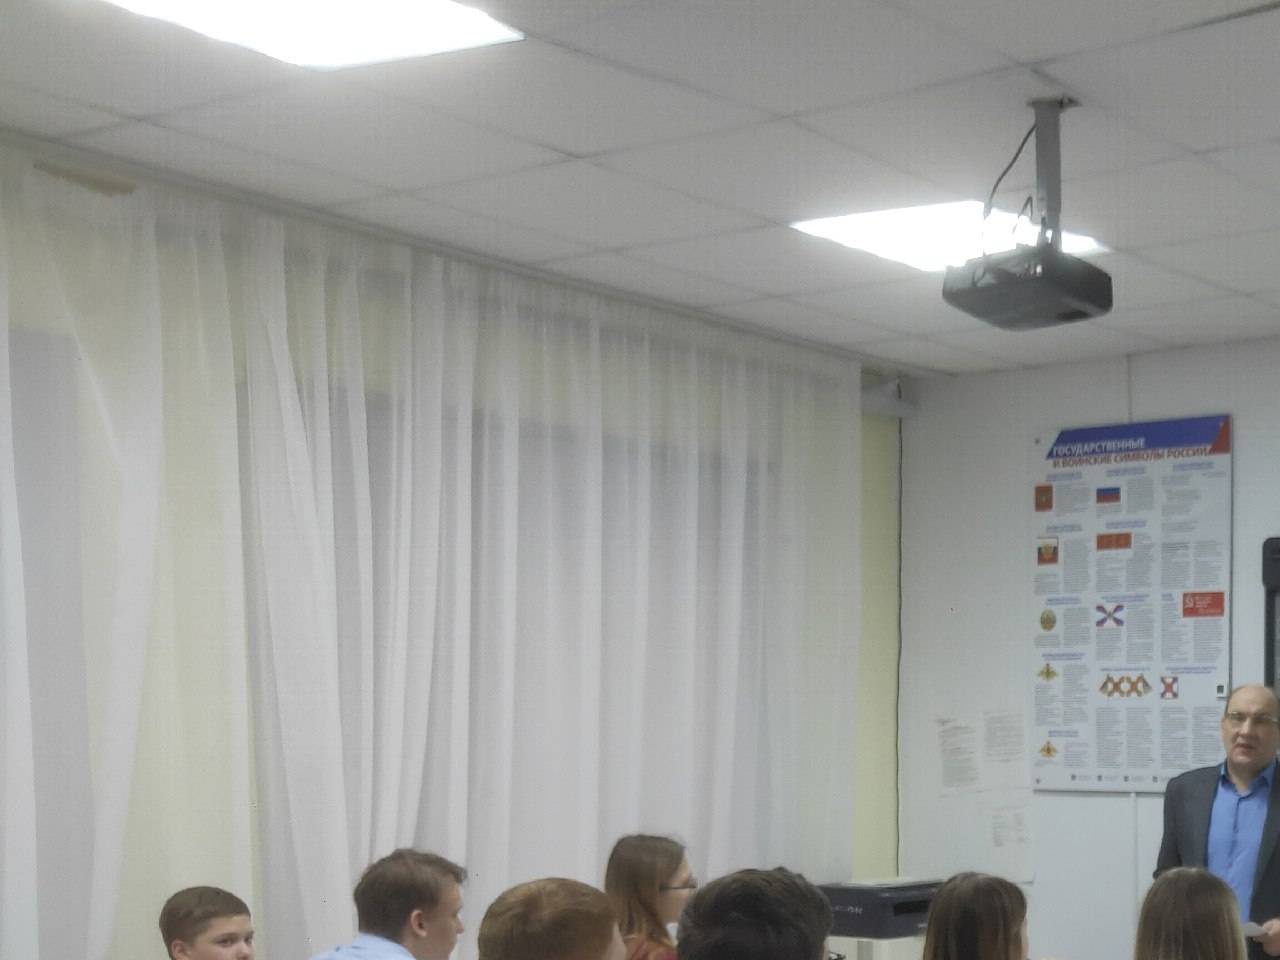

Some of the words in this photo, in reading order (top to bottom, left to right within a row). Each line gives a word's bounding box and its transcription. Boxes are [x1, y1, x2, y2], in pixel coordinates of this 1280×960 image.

[1053, 437, 1145, 458] ГОСУДАРСТВЕННЫЕ
[1053, 458, 1060, 468] И
[1062, 452, 1112, 468] ВОИНСКИЕ
[1114, 448, 1164, 464] СИМВОЛЫ
[1167, 445, 1210, 460] РОССИИ
